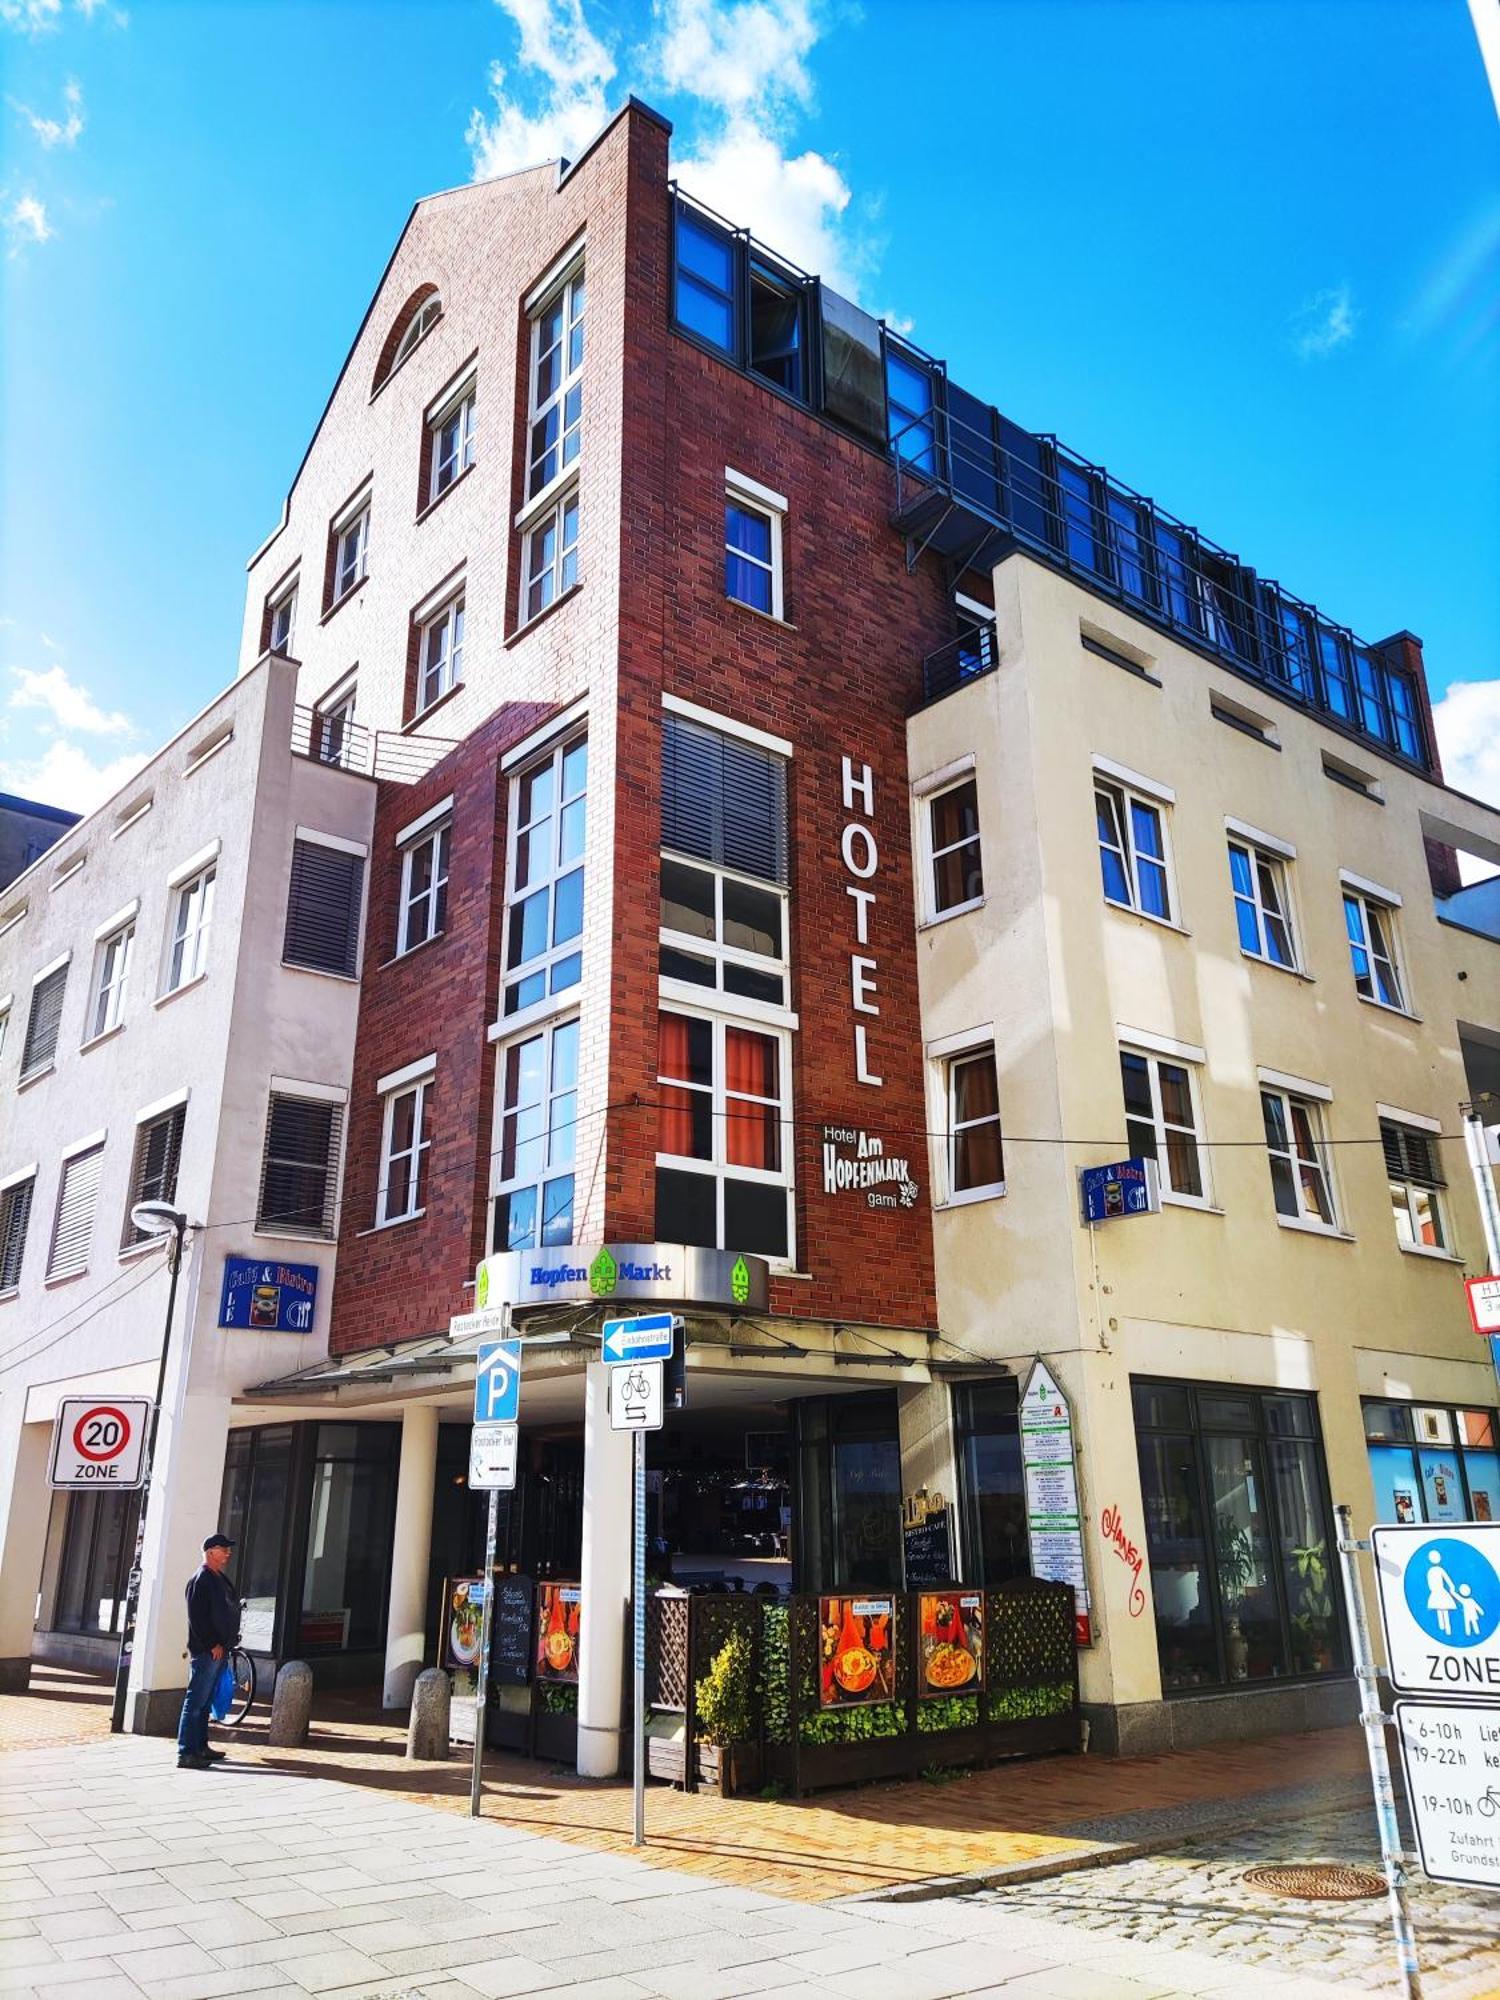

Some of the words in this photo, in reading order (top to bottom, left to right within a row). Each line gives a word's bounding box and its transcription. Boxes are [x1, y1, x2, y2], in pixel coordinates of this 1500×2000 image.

[841, 755, 883, 1087] HOTEL
[824, 1126, 857, 1144] Hotel
[857, 1131, 883, 1158] Am
[867, 1192, 897, 1208] garni
[261, 1266, 273, 1282] &
[275, 1265, 315, 1296] Bistro
[530, 1264, 588, 1288] Hopfen
[618, 1262, 672, 1281] Markt
[487, 1367, 508, 1417] P
[85, 1421, 119, 1447] 20
[75, 1464, 119, 1479] ZONE
[1426, 1655, 1500, 1684] ZONE
[1449, 1831, 1494, 1848] Zufahrt
